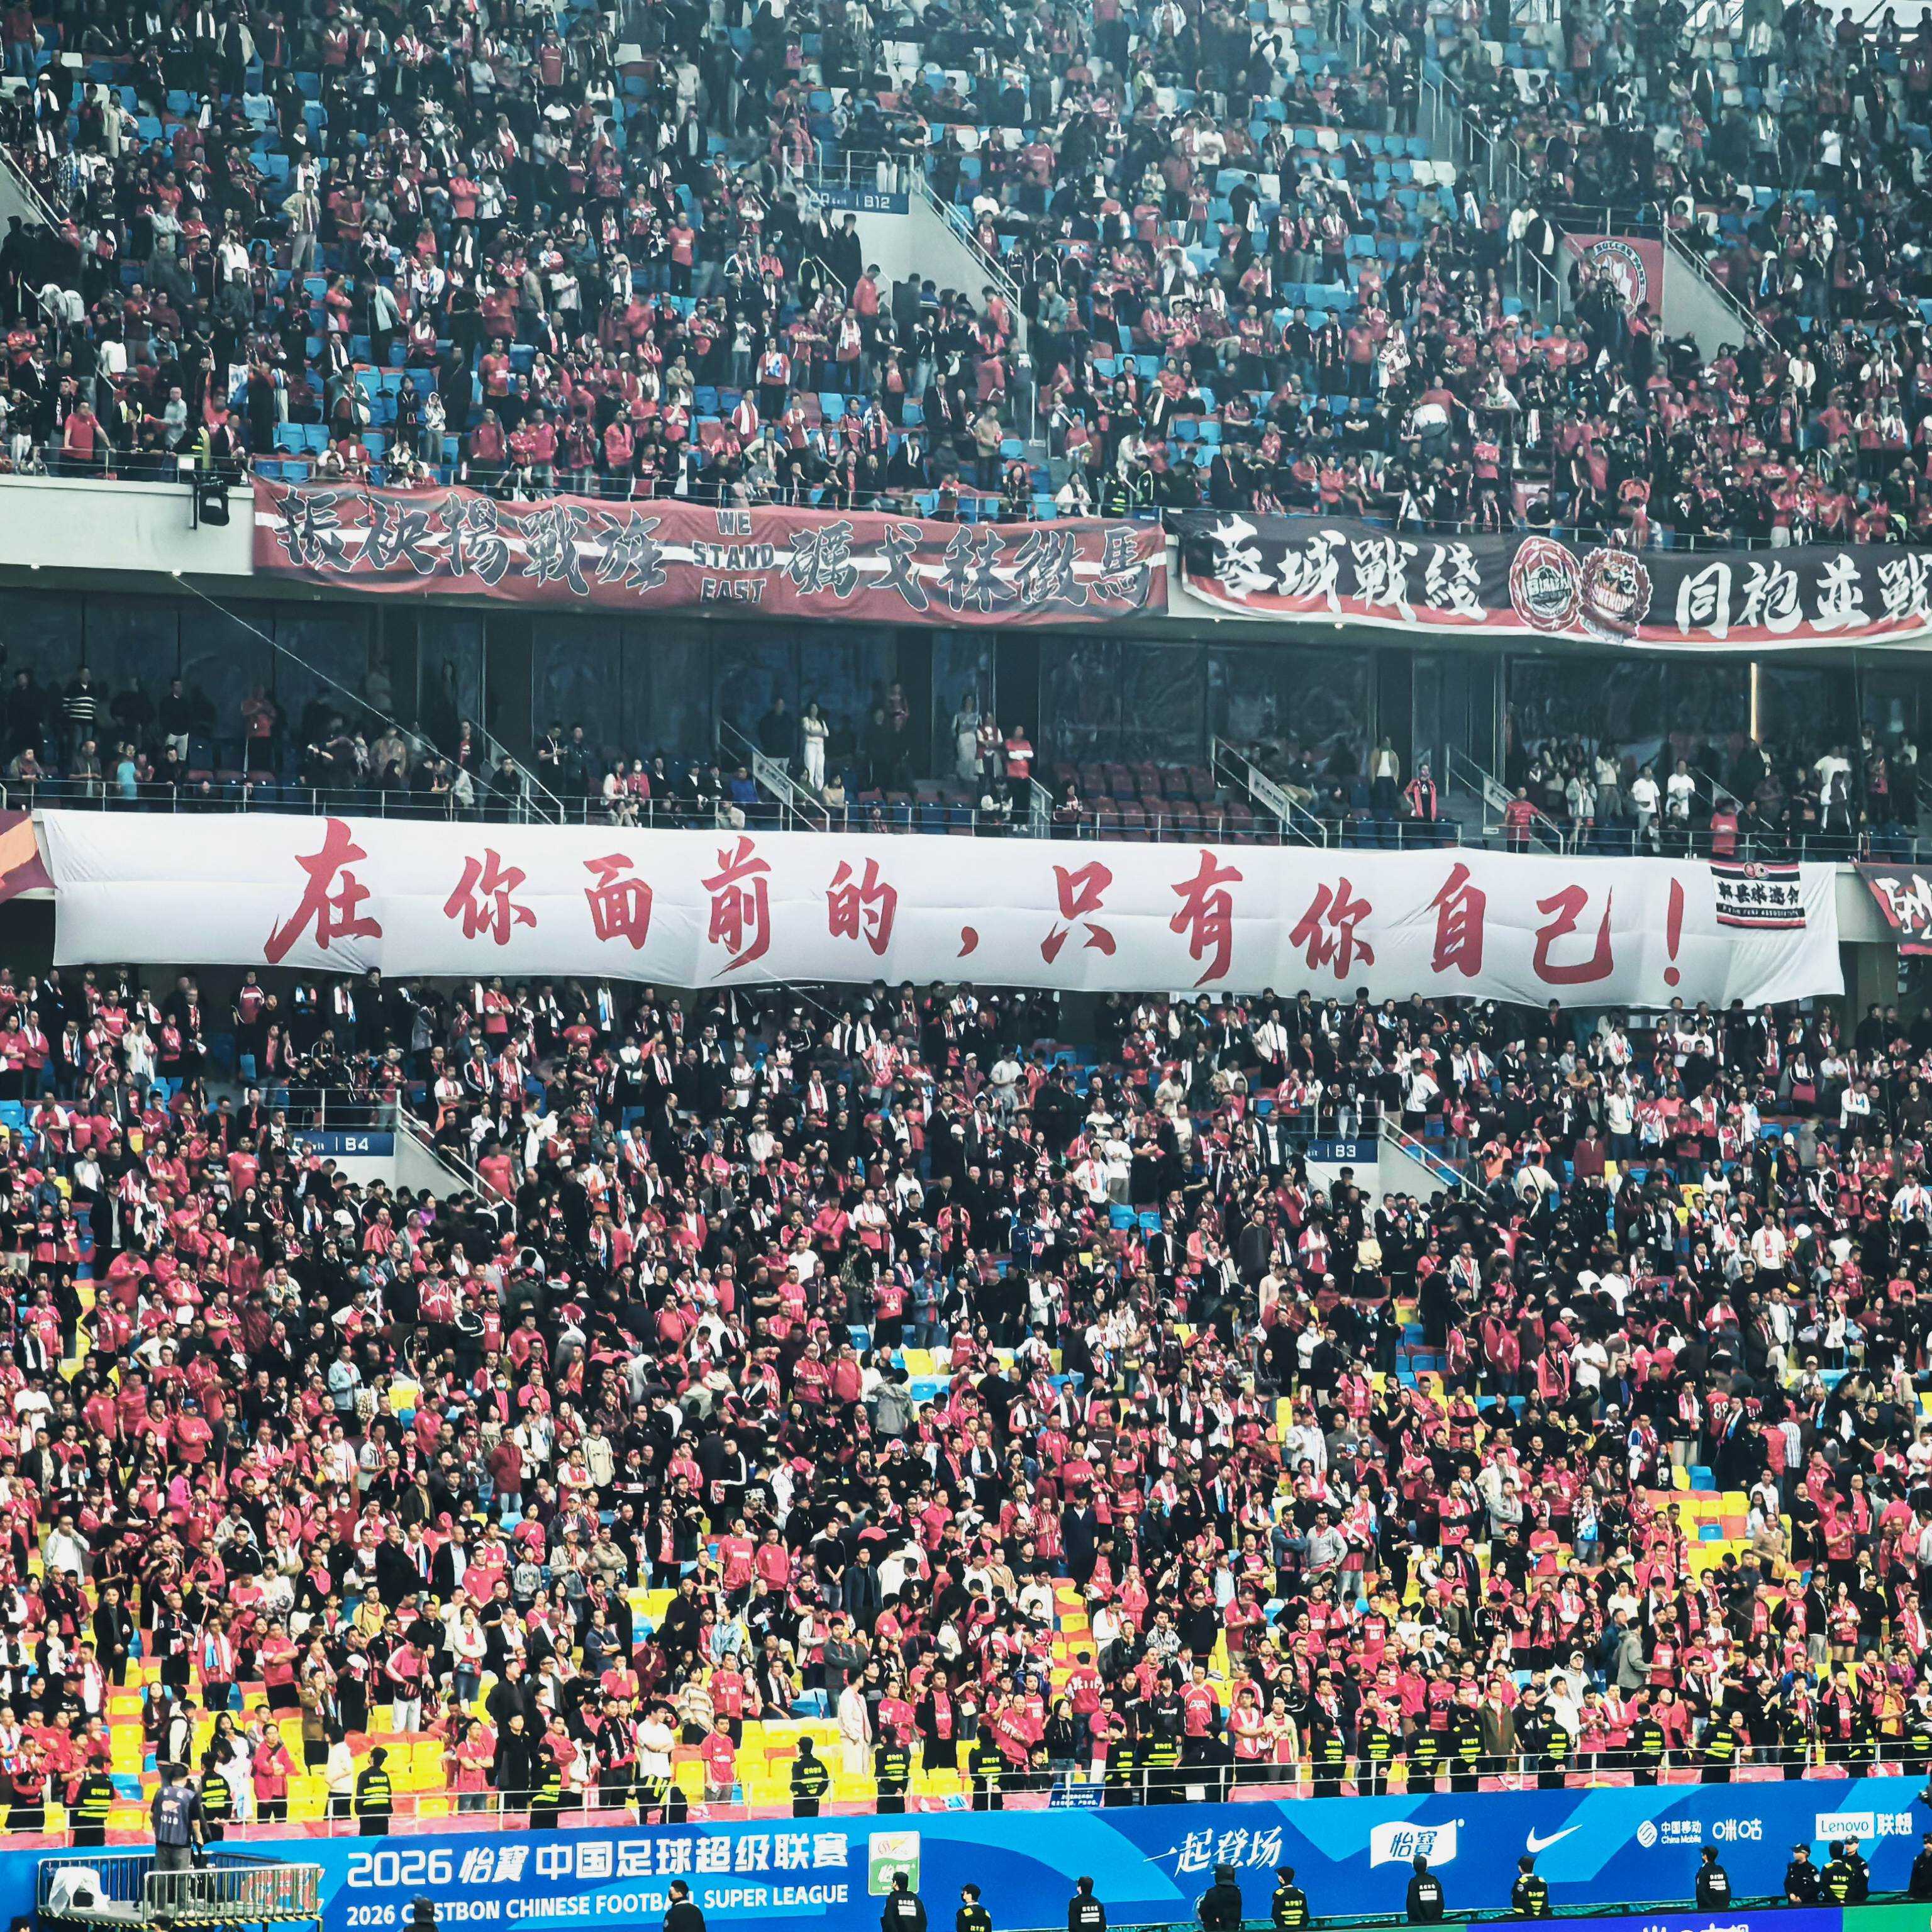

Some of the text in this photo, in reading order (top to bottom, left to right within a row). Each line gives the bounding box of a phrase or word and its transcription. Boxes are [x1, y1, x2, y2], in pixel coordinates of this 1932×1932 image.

[864, 195, 891, 209] B12
[716, 509, 752, 536] WE
[692, 541, 775, 570] STAND
[700, 578, 767, 604] EAST
[345, 1137, 369, 1151] B4
[1335, 1145, 1357, 1158] B3
[1661, 1820, 1702, 1835] 中国移动
[1712, 1818, 1763, 1841] 咪咕
[1821, 1812, 1913, 1836] Lenovo 联想
[1390, 1831, 1438, 1857] 怡寶
[1661, 1835, 1702, 1844] China Mobile
[347, 1848, 453, 1887] 2026
[536, 1832, 849, 1880] 中国足球超级联赛
[347, 1884, 848, 1926] 2026 CSTBON CHINESE FOOTBL SUPER LEAGUE
